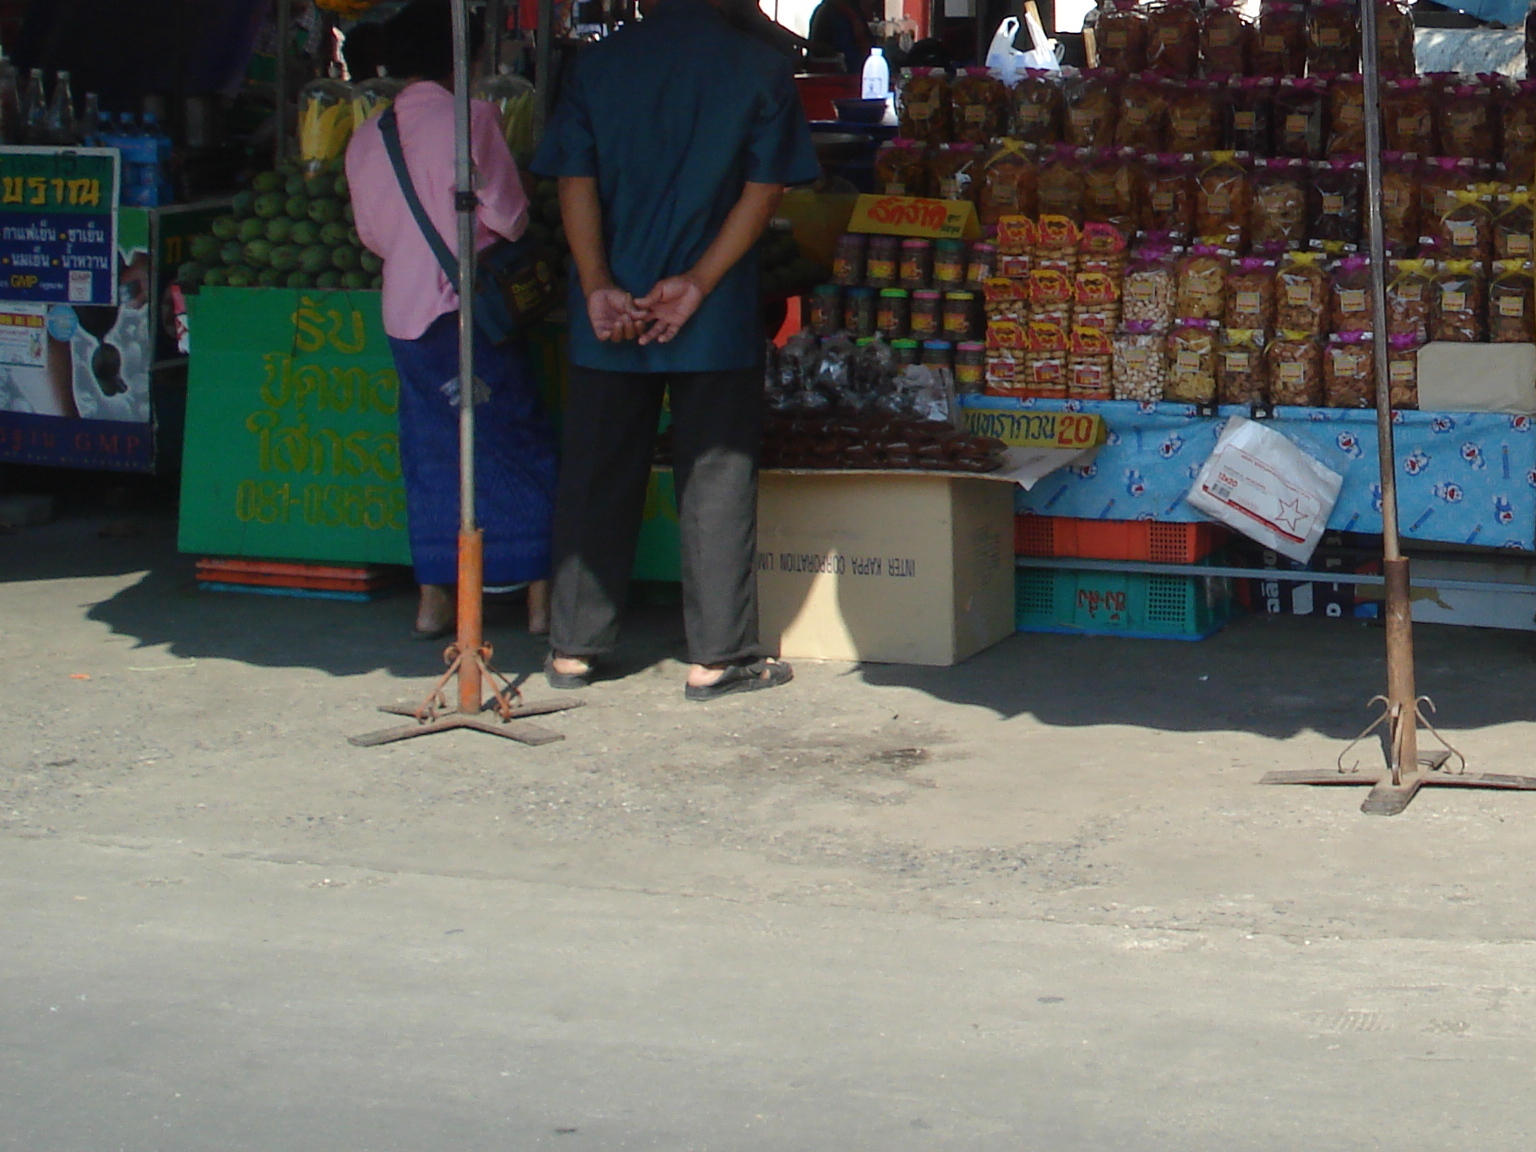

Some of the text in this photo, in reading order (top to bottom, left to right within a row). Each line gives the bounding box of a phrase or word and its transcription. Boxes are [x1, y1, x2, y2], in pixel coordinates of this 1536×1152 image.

[10, 273, 39, 289] GMP
[289, 296, 366, 354] รับ
[1057, 415, 1094, 445] 20
[780, 552, 846, 576] CORPORATION
[851, 557, 882, 576] KAPPA
[888, 557, 916, 578] INTER
